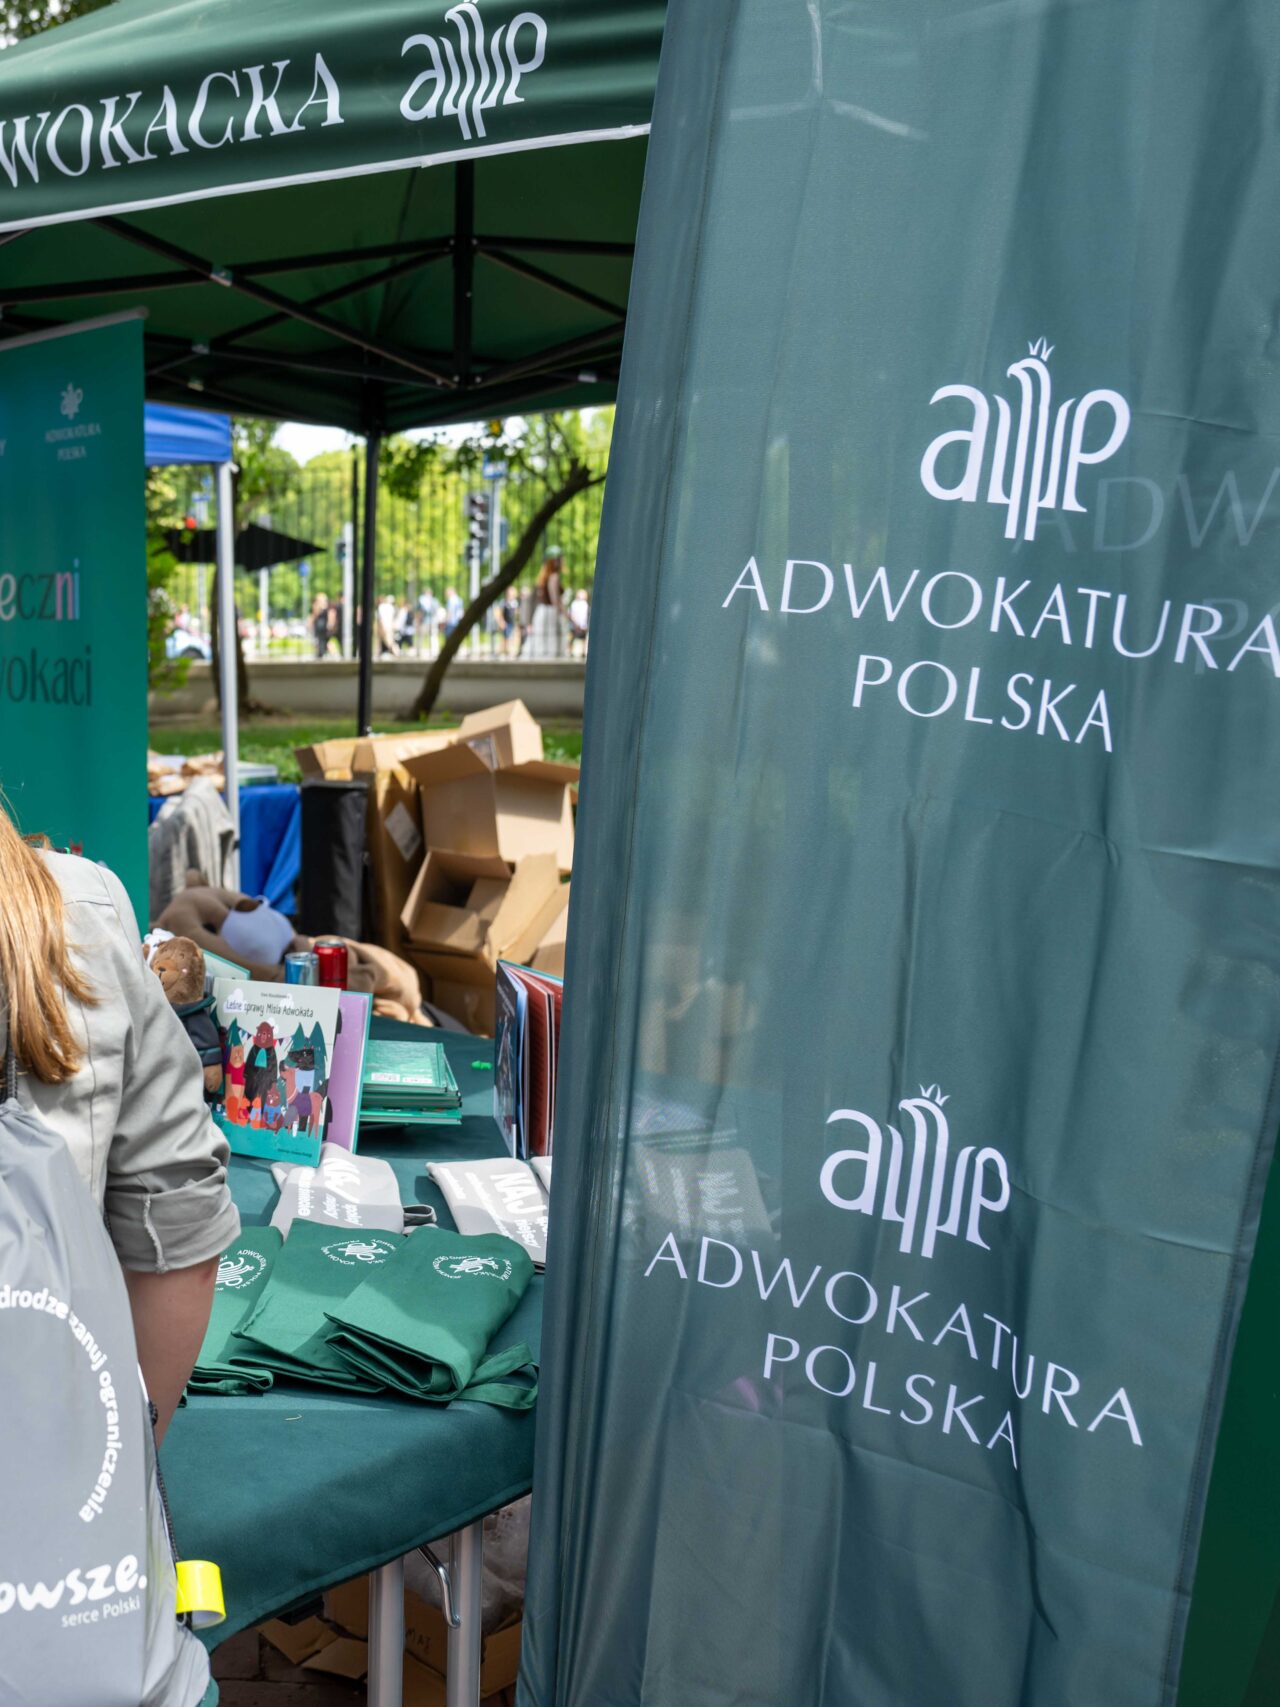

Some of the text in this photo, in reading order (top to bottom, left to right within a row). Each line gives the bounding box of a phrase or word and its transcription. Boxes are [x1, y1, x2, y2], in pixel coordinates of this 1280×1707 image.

[722, 555, 1280, 678] ADWOKATURA
[852, 655, 1113, 752] POLSKA
[283, 1005, 314, 1018] Adwokata
[68, 1310, 108, 1372] zanuj
[644, 1232, 1143, 1447] ADWOKATURA
[78, 1370, 123, 1523] ograniczenia
[763, 1333, 1018, 1470] POLSKA
[61, 1595, 141, 1629] serce Polski
